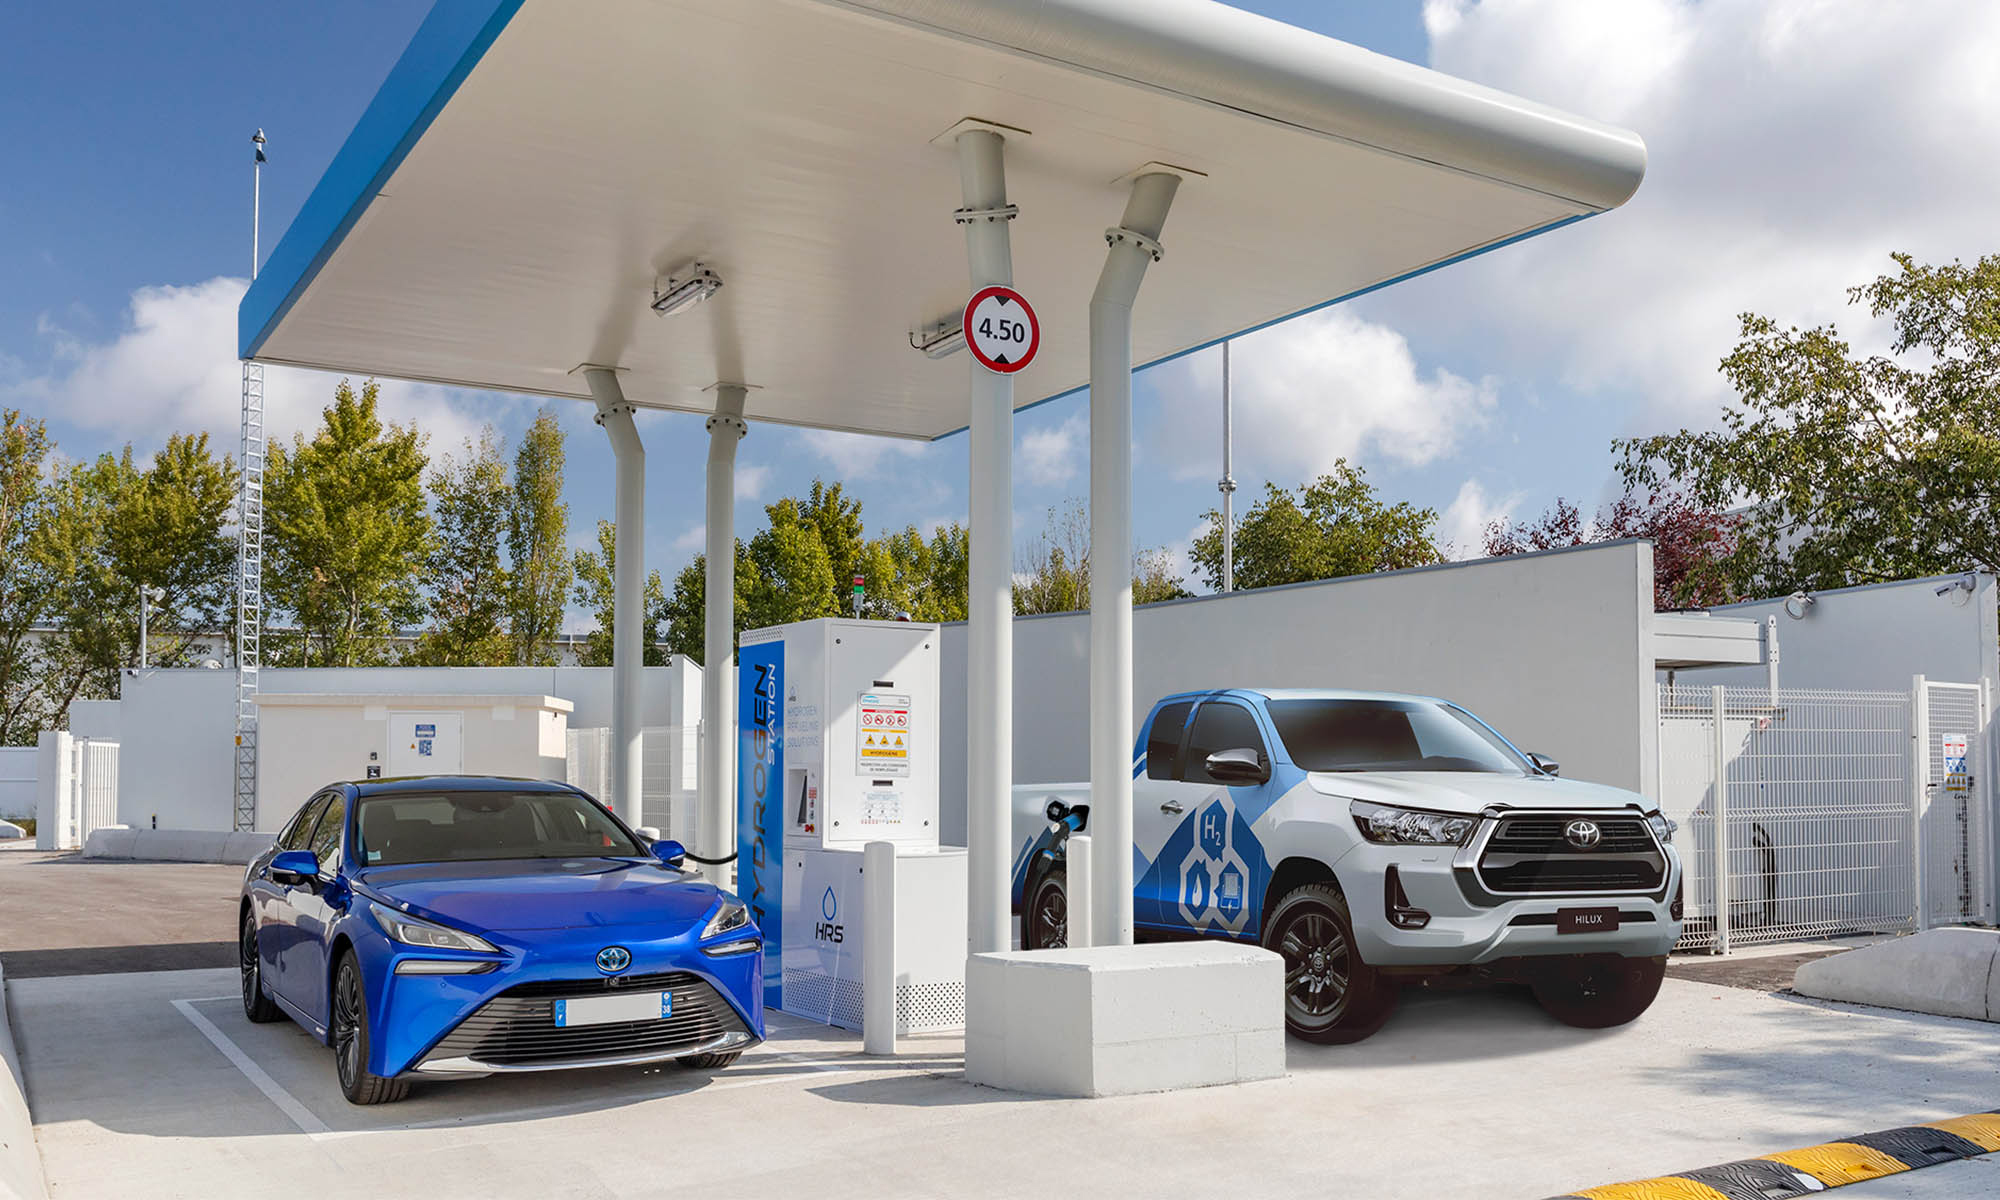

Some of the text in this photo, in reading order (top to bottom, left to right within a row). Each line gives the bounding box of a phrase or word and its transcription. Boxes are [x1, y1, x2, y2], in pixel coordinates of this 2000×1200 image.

[979, 317, 1025, 343] 4.50
[768, 664, 776, 766] STATION
[752, 664, 767, 939] HYDROGEN
[1575, 914, 1603, 924] HILUX
[816, 922, 844, 943] HRS
